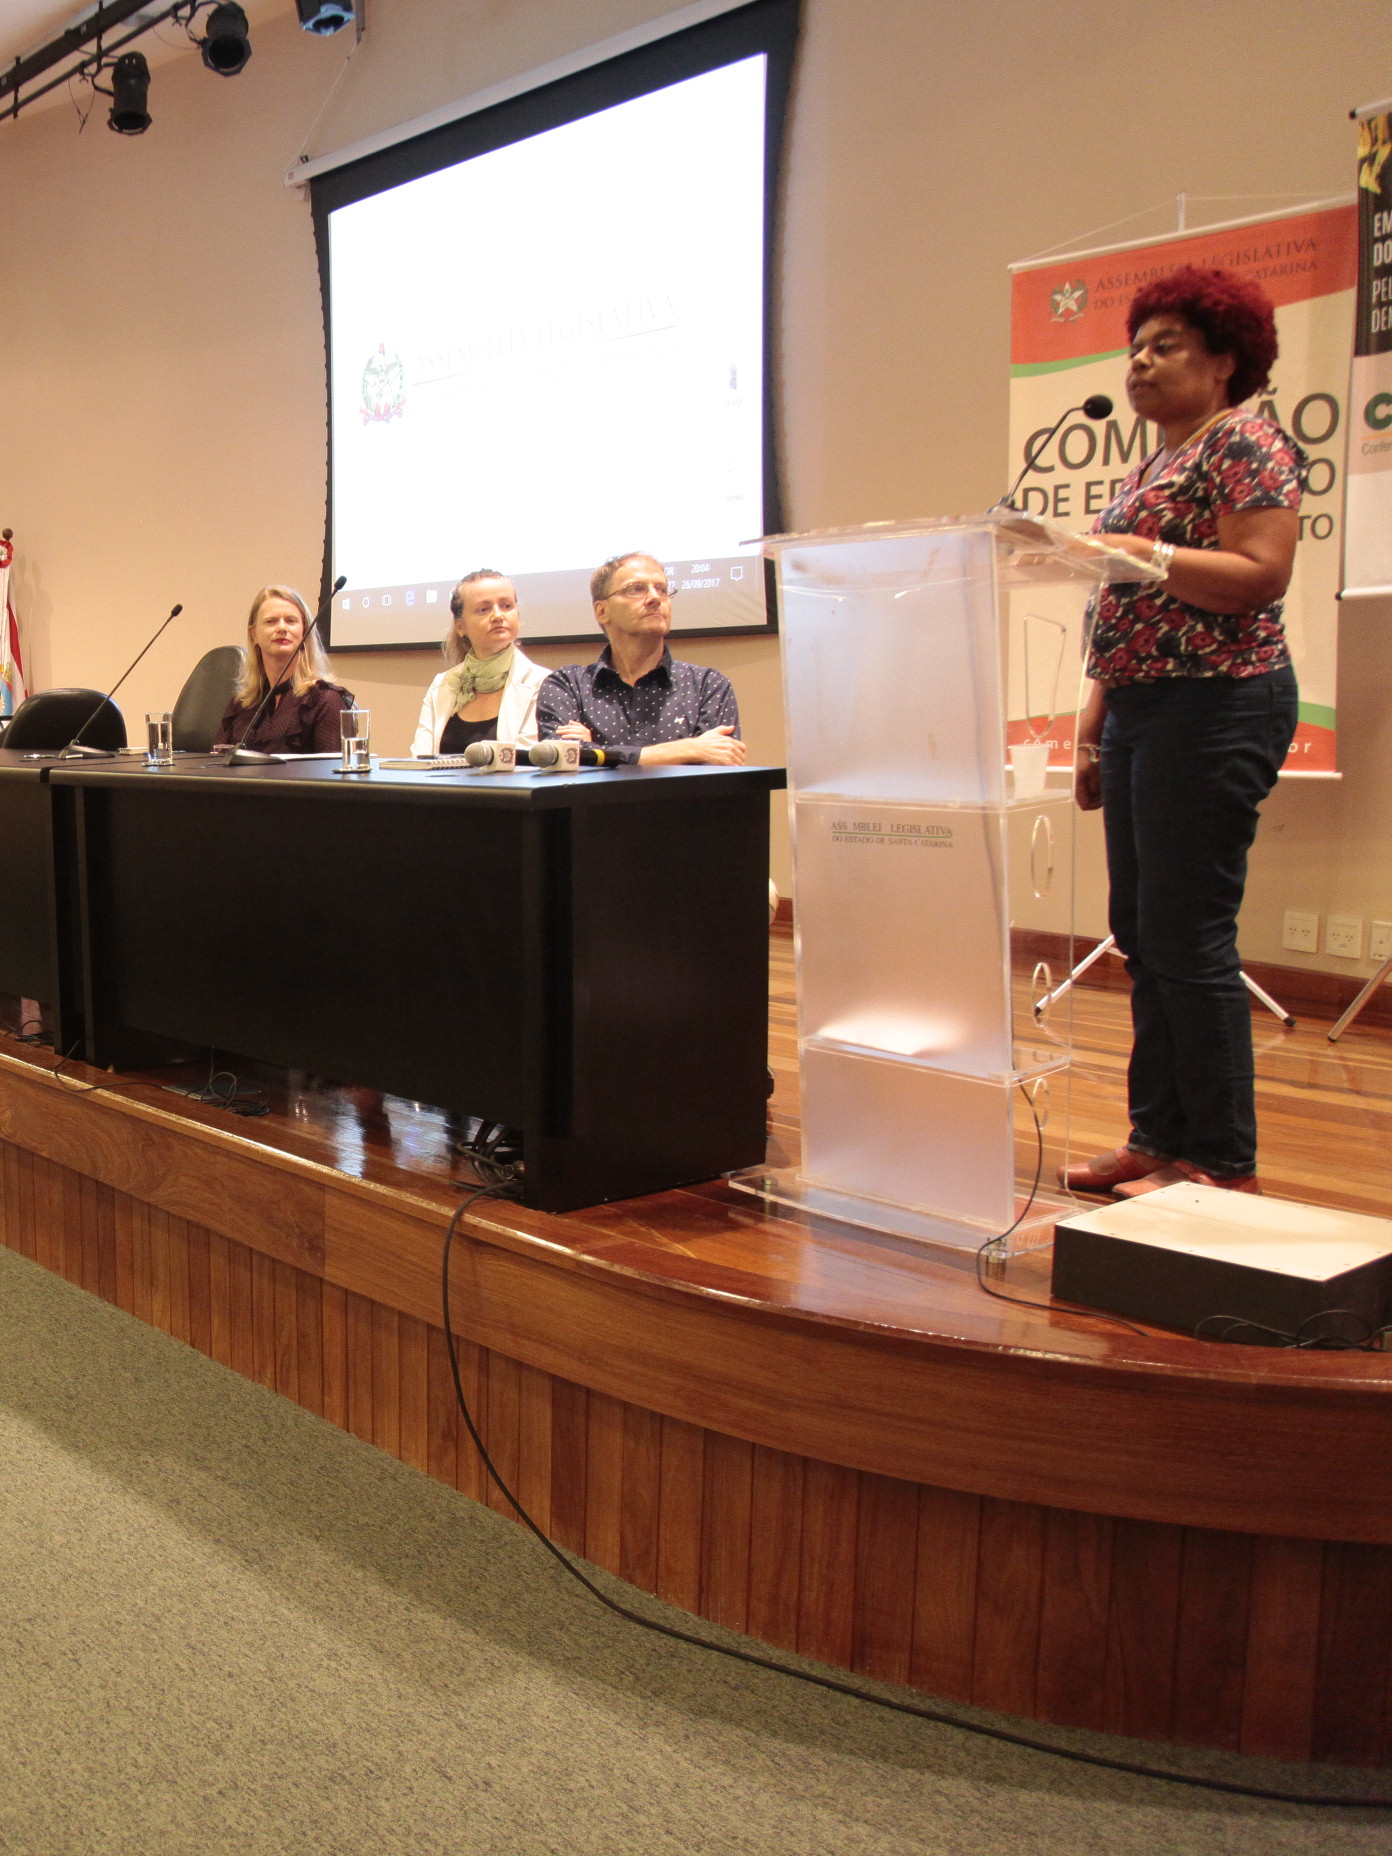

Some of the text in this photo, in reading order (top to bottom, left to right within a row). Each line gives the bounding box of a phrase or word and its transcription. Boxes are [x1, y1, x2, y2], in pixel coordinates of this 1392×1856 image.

[690, 563, 709, 574] 20:04
[681, 578, 720, 590] 26/09/2017
[889, 823, 953, 838] LEGISLATIVA
